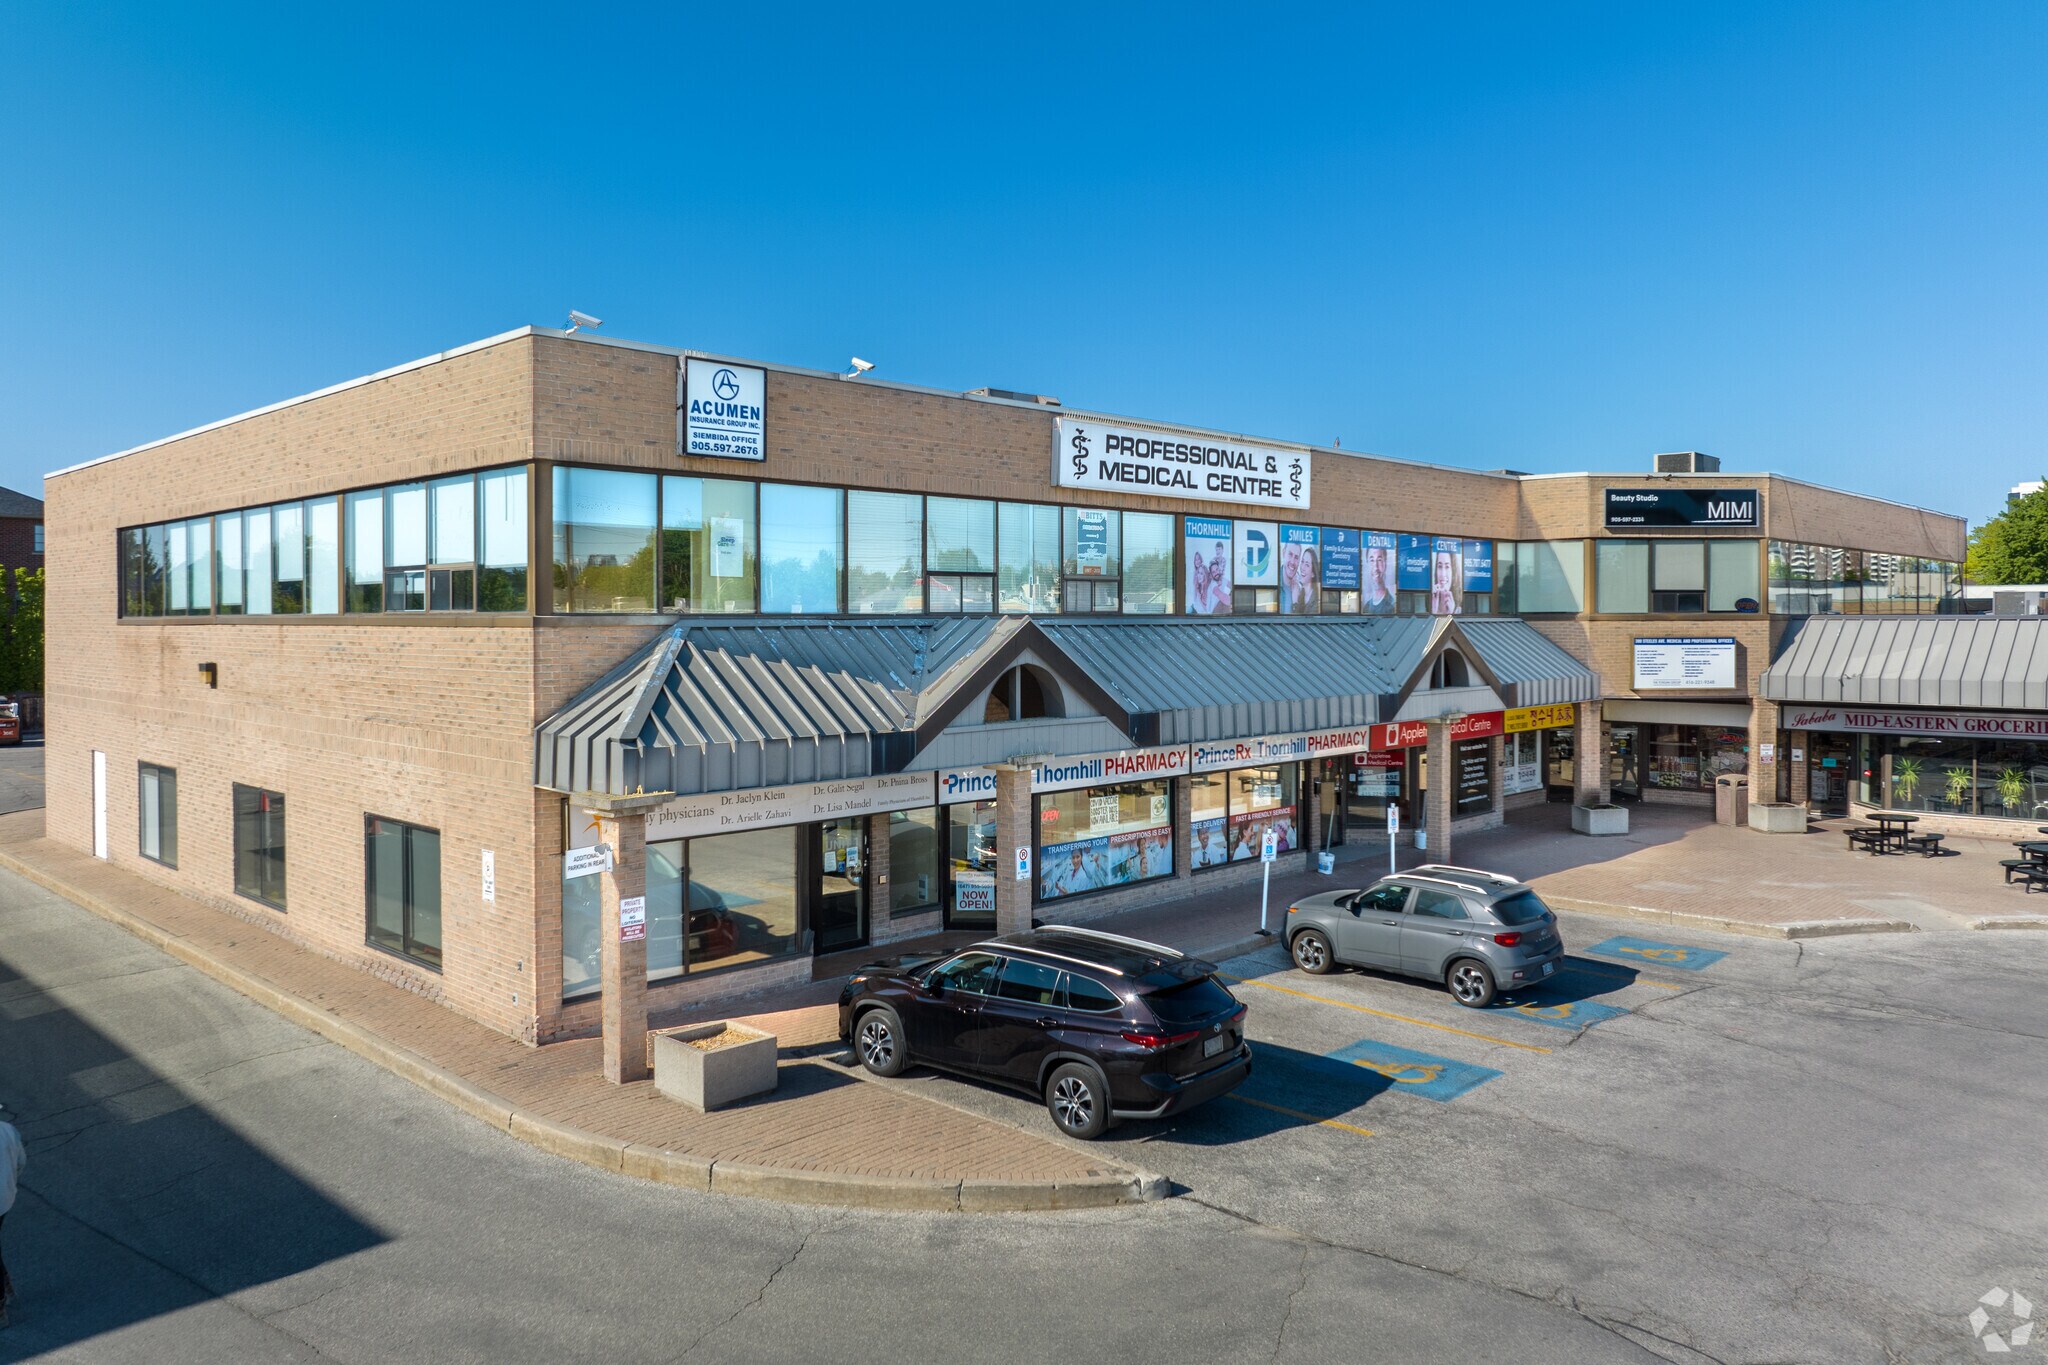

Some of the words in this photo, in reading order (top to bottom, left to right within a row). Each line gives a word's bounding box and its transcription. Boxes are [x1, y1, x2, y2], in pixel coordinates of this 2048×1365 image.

[690, 399, 760, 420] ACUMEN
[689, 415, 725, 426] INSURANCE
[727, 419, 747, 428] GROUP
[693, 431, 729, 441] SIEMBIDA
[731, 435, 757, 444] OFFICE
[691, 441, 758, 455] 905.597.2676
[1105, 434, 1258, 472] PROFESSIONAL
[1264, 455, 1277, 473] &
[1099, 460, 1198, 489] MEDICAL
[1206, 473, 1282, 498] CENTRE
[1611, 494, 1635, 502] Beauty
[1708, 501, 1752, 519] MIMI
[1186, 522, 1231, 537] THORNHILL
[1288, 529, 1313, 542] SMILES
[1367, 535, 1391, 548] DENTAL
[1436, 540, 1457, 552] CENTRE
[1845, 714, 1958, 730] MID-EASTERN
[1400, 723, 1428, 743] Applet
[1469, 718, 1491, 732] Centre
[1257, 737, 1306, 758] Thornhill
[1308, 731, 1368, 751] PHARMACY
[948, 773, 997, 794] Prince
[1105, 750, 1187, 776] PHARMACY
[813, 786, 826, 796] Dr.
[827, 783, 845, 794] Galit
[846, 781, 865, 794] Segal
[877, 779, 889, 788] Dr.
[910, 775, 928, 785] Bross
[721, 795, 734, 806] Dr.
[735, 793, 762, 805] Jaclyn
[763, 791, 786, 803] Klein
[813, 804, 826, 814] Dr.
[827, 801, 843, 812] Lisa
[845, 798, 872, 811] Mandel
[658, 805, 715, 825] physicians
[721, 815, 734, 826] Dr.
[736, 811, 763, 824] Arielle
[765, 808, 792, 820] Zahavi
[1041, 810, 1060, 821] OPEN
[1252, 811, 1272, 820] FRIENDLY
[1272, 807, 1290, 816] SERVICE
[1048, 840, 1091, 854] TRANSFERRING
[1092, 838, 1108, 847] YOUR
[1110, 830, 1152, 844] PRESCRIPTIONS
[1158, 828, 1172, 836] EASY
[573, 852, 599, 862] ADDITIONAL
[567, 862, 587, 871] PARKING
[593, 859, 605, 867] REAR
[962, 890, 988, 899] NOW
[622, 906, 643, 914] PROPERTY
[624, 899, 641, 907] PRIVATE
[959, 900, 992, 909] OPEN!
